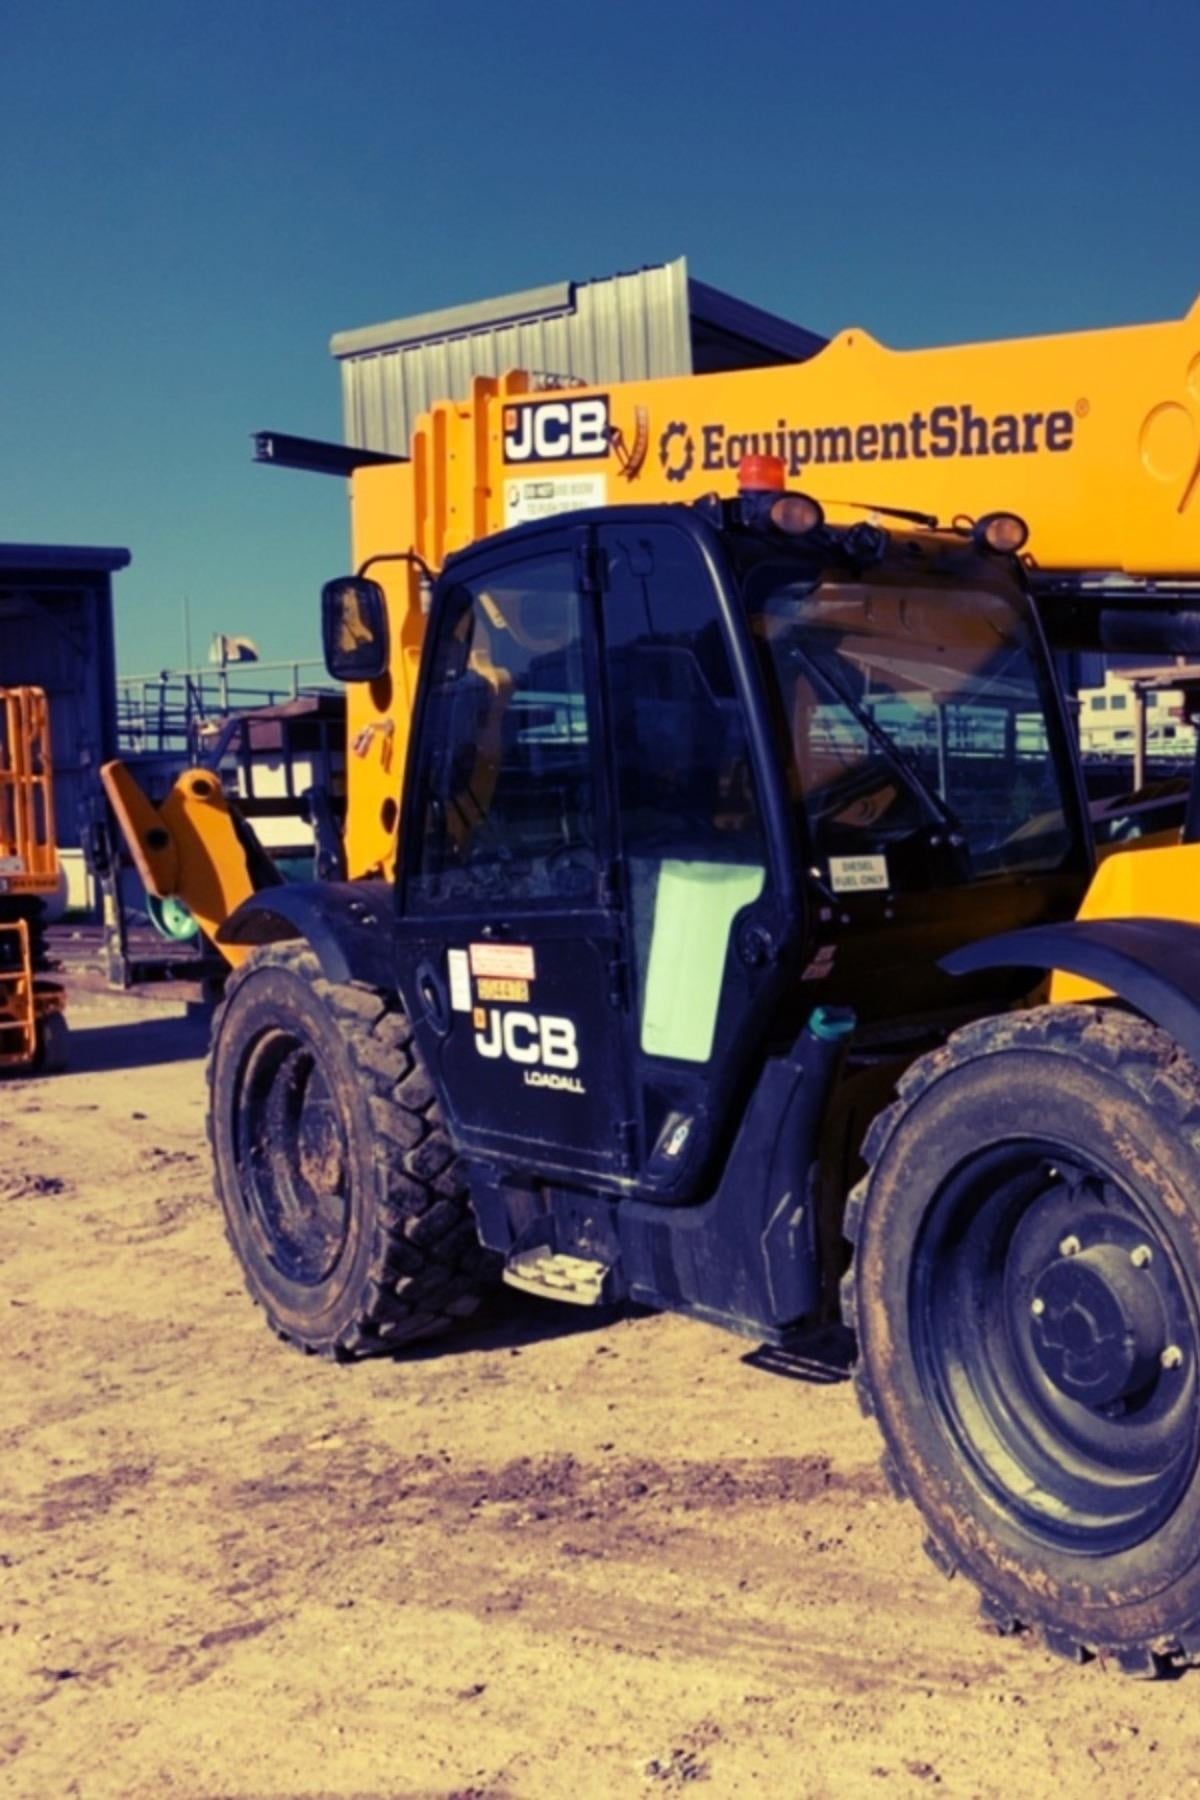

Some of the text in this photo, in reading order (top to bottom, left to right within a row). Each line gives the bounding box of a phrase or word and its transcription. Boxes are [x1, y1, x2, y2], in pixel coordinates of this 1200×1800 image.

[504, 400, 607, 459] JCB
[701, 405, 1074, 476] EquipmentShare
[475, 1008, 579, 1070] JCB
[523, 1070, 586, 1094] LOADALL
